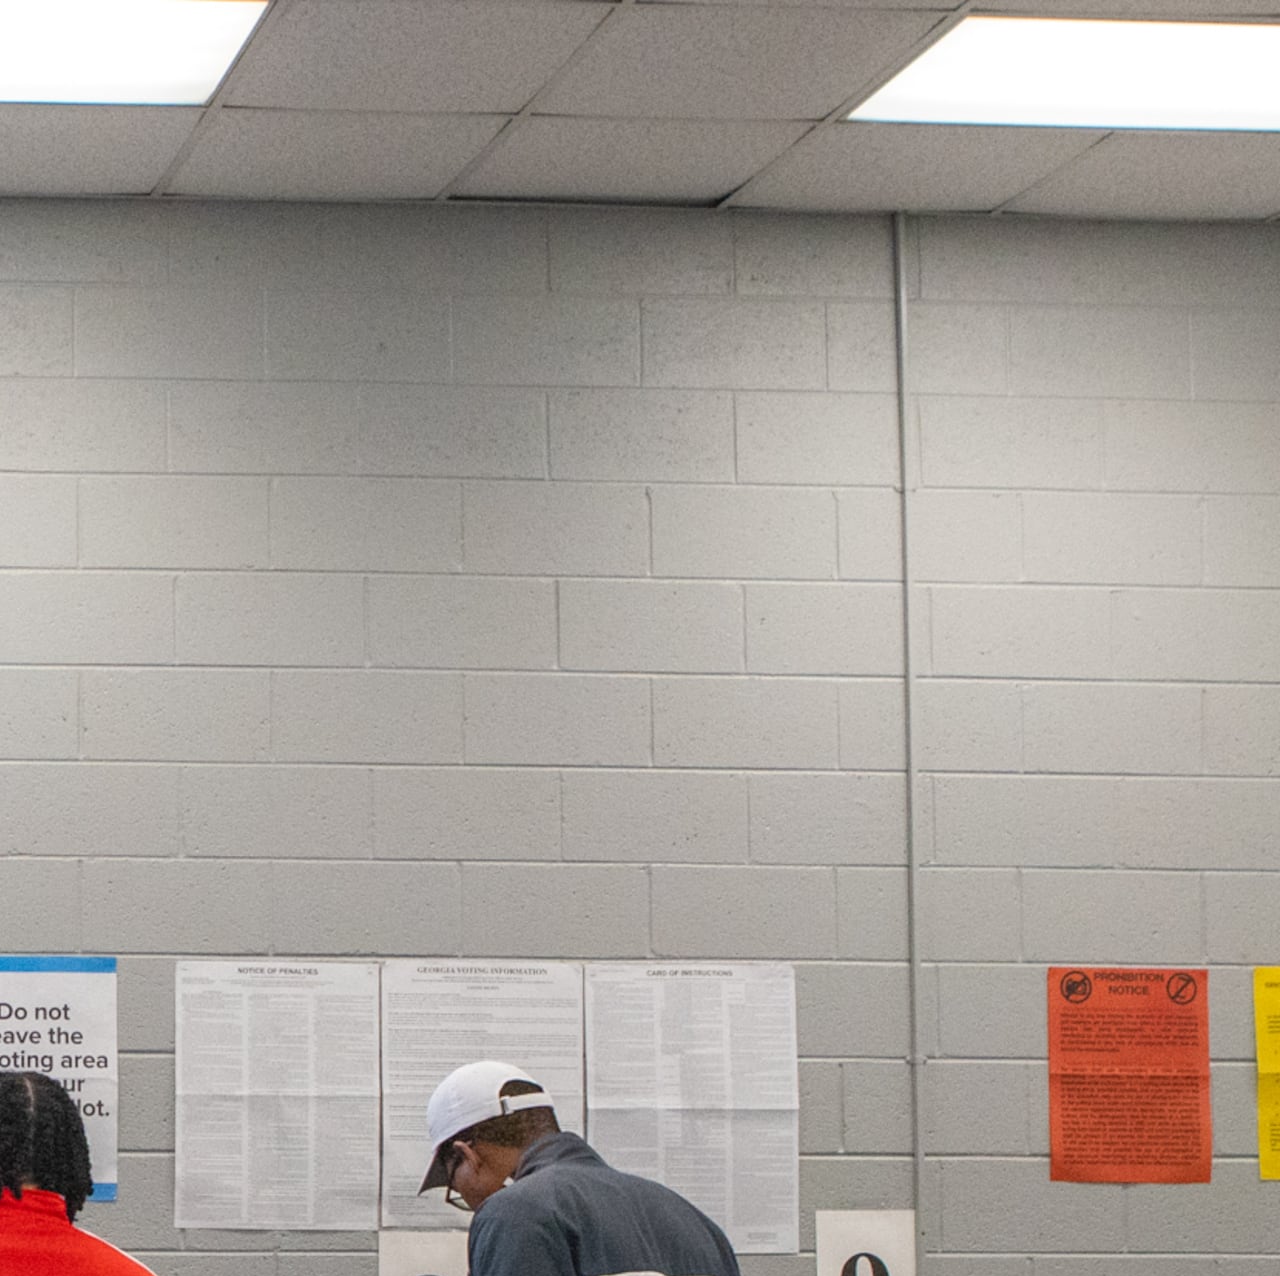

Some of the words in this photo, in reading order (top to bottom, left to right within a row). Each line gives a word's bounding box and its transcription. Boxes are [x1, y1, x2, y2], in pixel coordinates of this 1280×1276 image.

[279, 968, 319, 976] PENALTIES
[417, 967, 455, 975] GEORGIA
[456, 967, 489, 975] VOTING
[490, 967, 548, 976] INFORMATION
[646, 969, 668, 977] CARD
[669, 969, 679, 977] OF
[681, 969, 734, 978] INSTRUCTIONS
[1093, 972, 1165, 983] PROHIBITION
[1108, 985, 1150, 996] NOTICE
[35, 1003, 70, 1020] not
[48, 1027, 83, 1044] the
[61, 1054, 109, 1069] area
